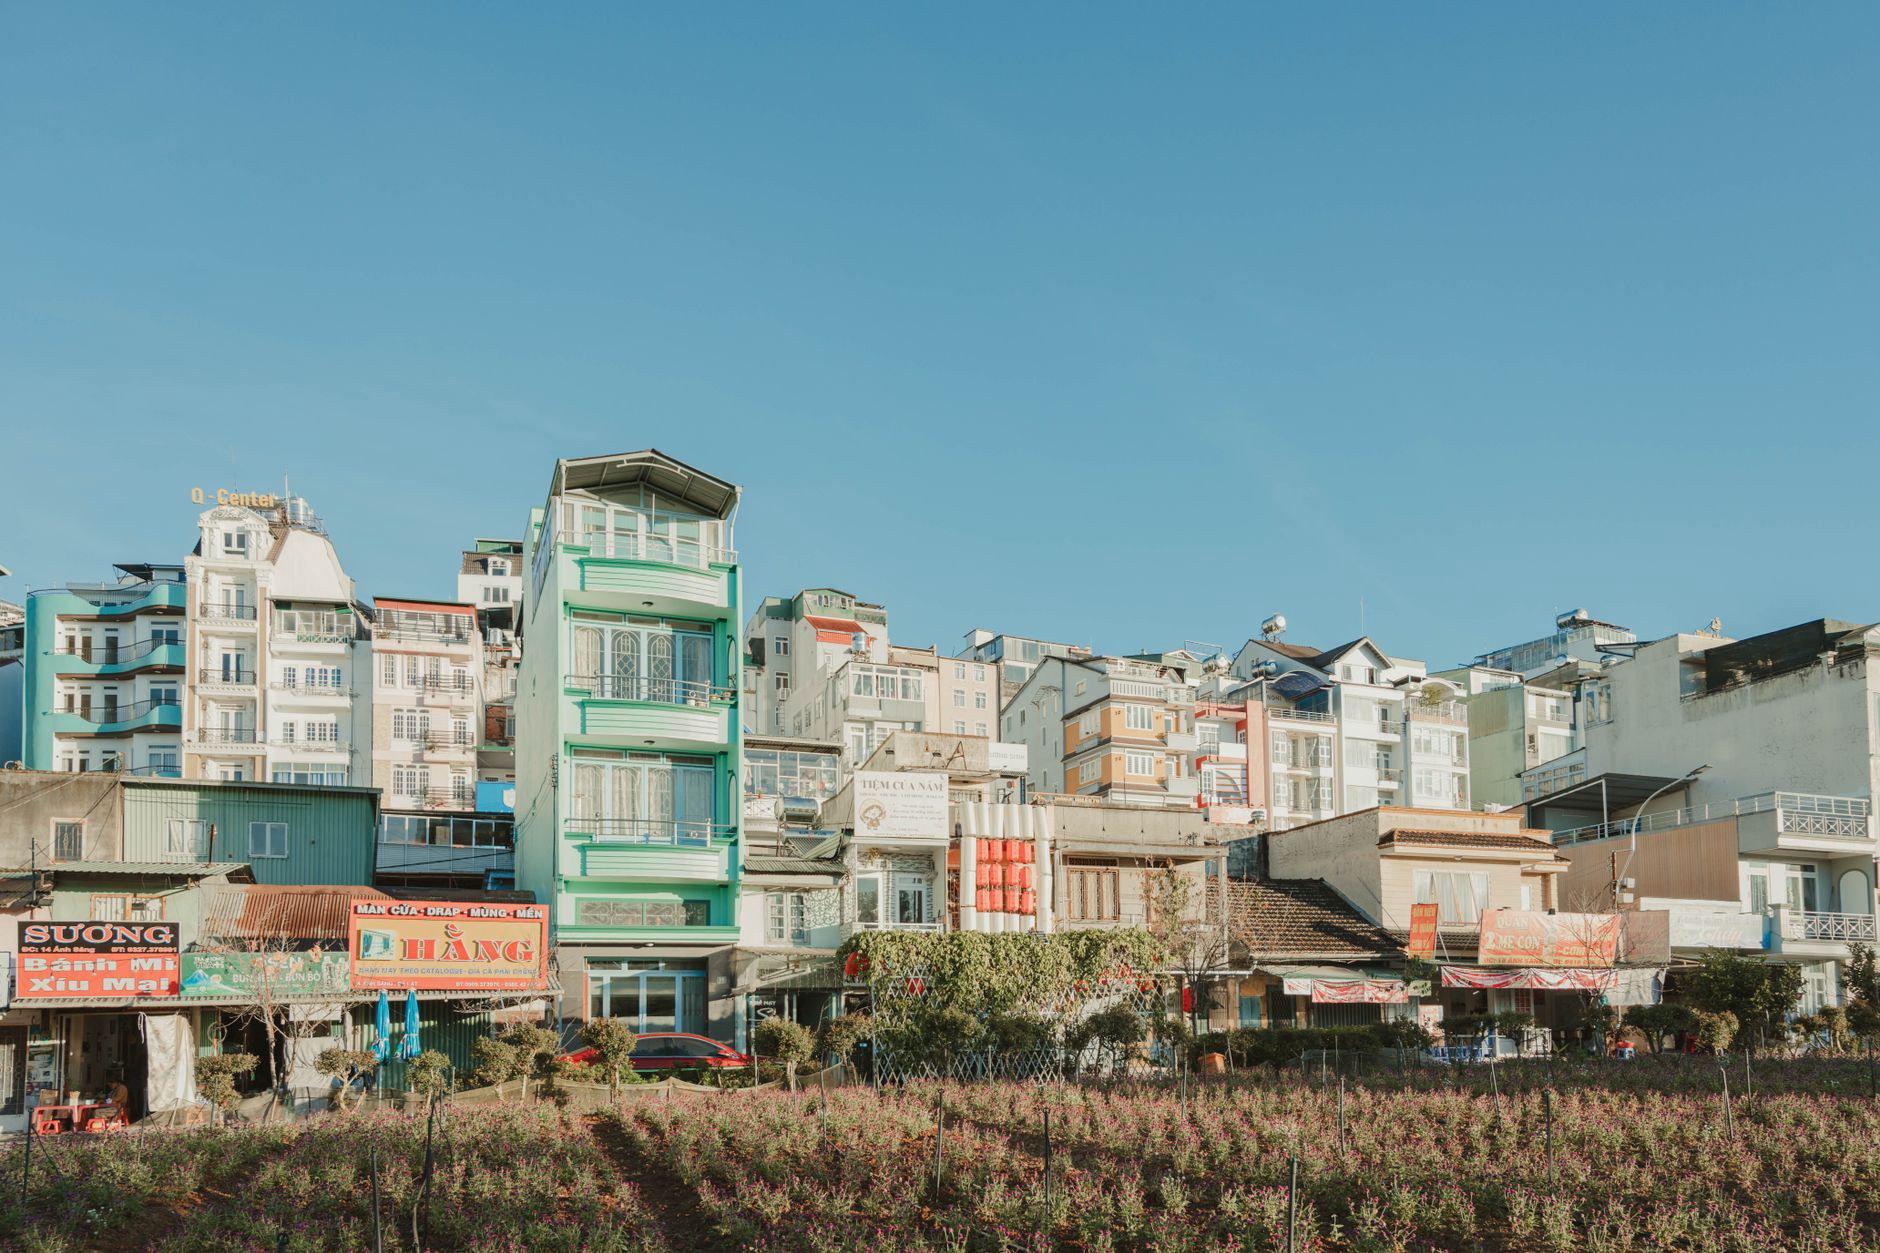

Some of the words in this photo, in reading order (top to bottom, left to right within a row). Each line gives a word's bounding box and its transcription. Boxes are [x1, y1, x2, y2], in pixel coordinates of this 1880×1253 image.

[191, 487, 204, 504] Q
[217, 488, 274, 507] Center
[861, 779, 889, 791] TIỆM
[357, 903, 385, 914] MÀN
[426, 907, 461, 916] DRAP
[470, 906, 507, 918] MÙNG
[24, 923, 174, 944] SƯƠNG
[401, 922, 534, 963] HẰNG
[23, 957, 117, 972] Bánh
[130, 957, 176, 972] Mì
[28, 977, 89, 992] Xíu
